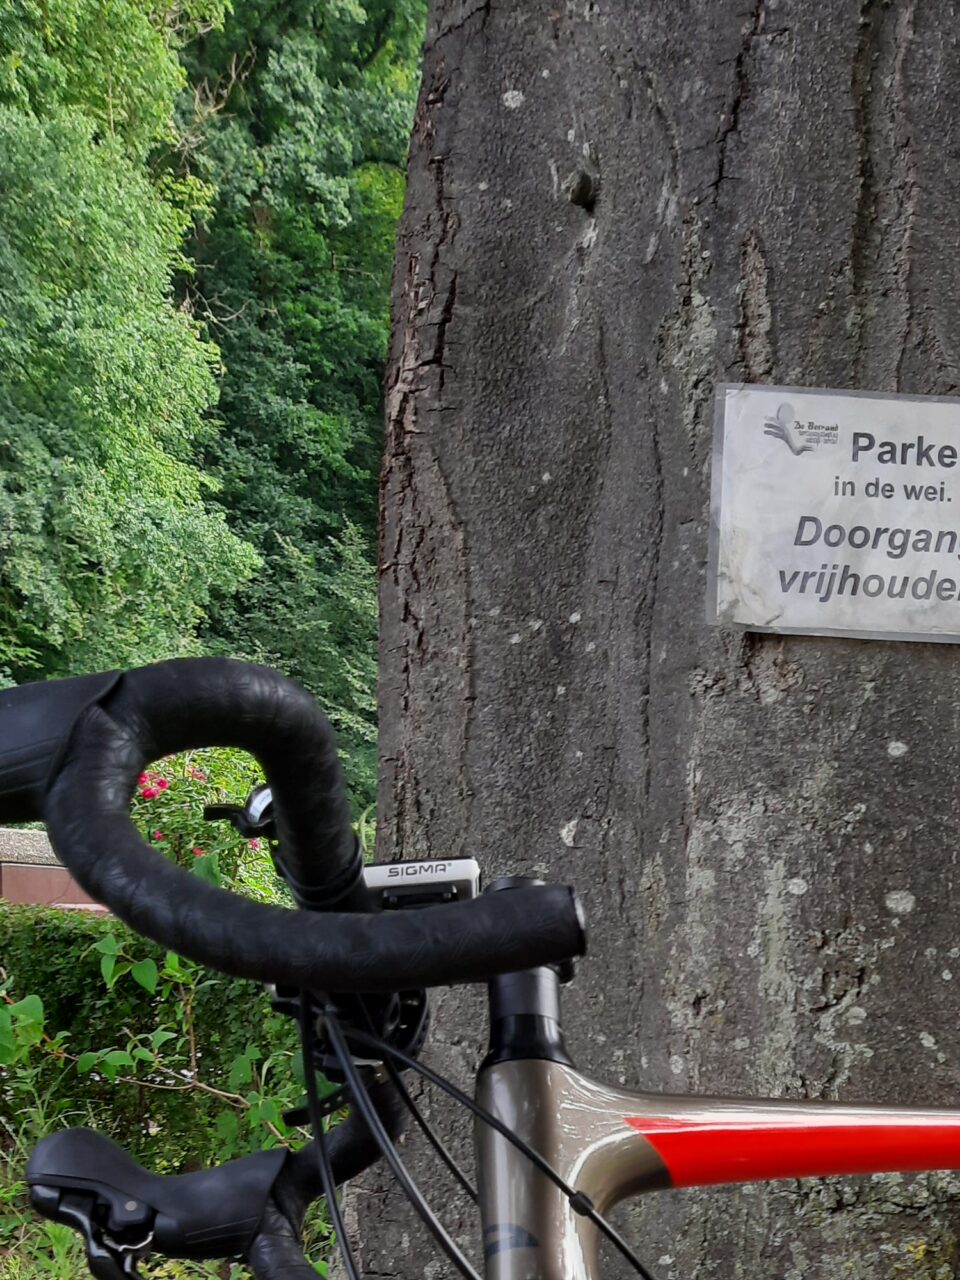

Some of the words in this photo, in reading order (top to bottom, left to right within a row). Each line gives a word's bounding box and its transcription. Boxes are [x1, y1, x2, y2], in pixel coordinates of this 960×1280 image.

[834, 476, 855, 497] in
[864, 477, 895, 498] de
[904, 481, 952, 502] wei.
[387, 863, 447, 877] SIGMA
